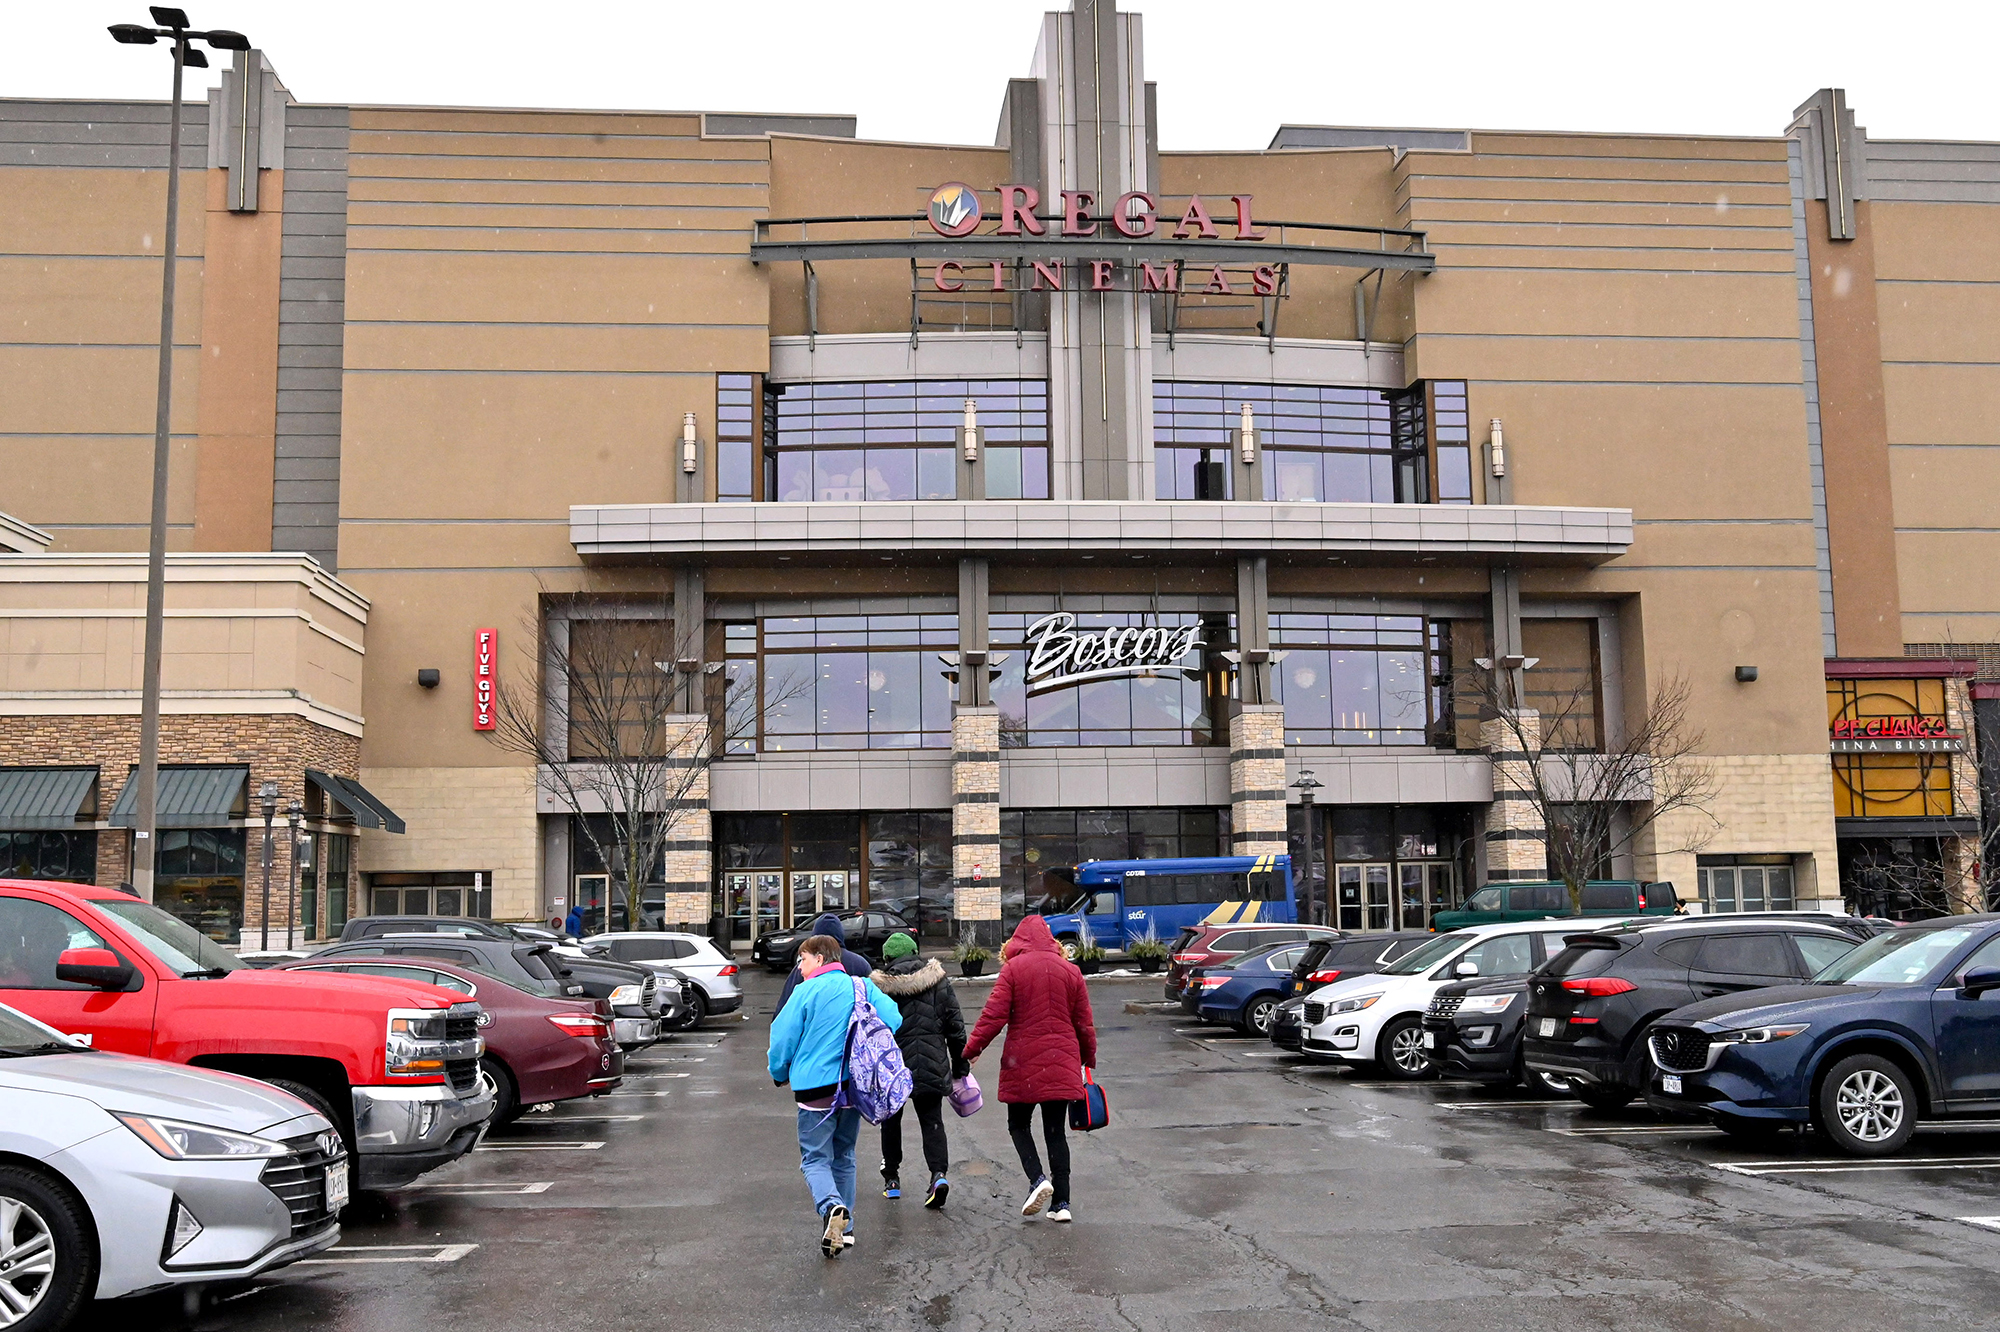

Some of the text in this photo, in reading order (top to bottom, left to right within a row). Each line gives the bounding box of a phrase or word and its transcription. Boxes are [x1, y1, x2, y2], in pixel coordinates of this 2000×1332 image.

[995, 183, 1271, 241] REGAL
[933, 260, 1277, 296] CINEMAS
[1027, 611, 1207, 676] Boscov's
[478, 632, 490, 725] FIVE GUYS
[1829, 739, 1963, 750] HINA BISTRO
[1128, 909, 1147, 920] star
